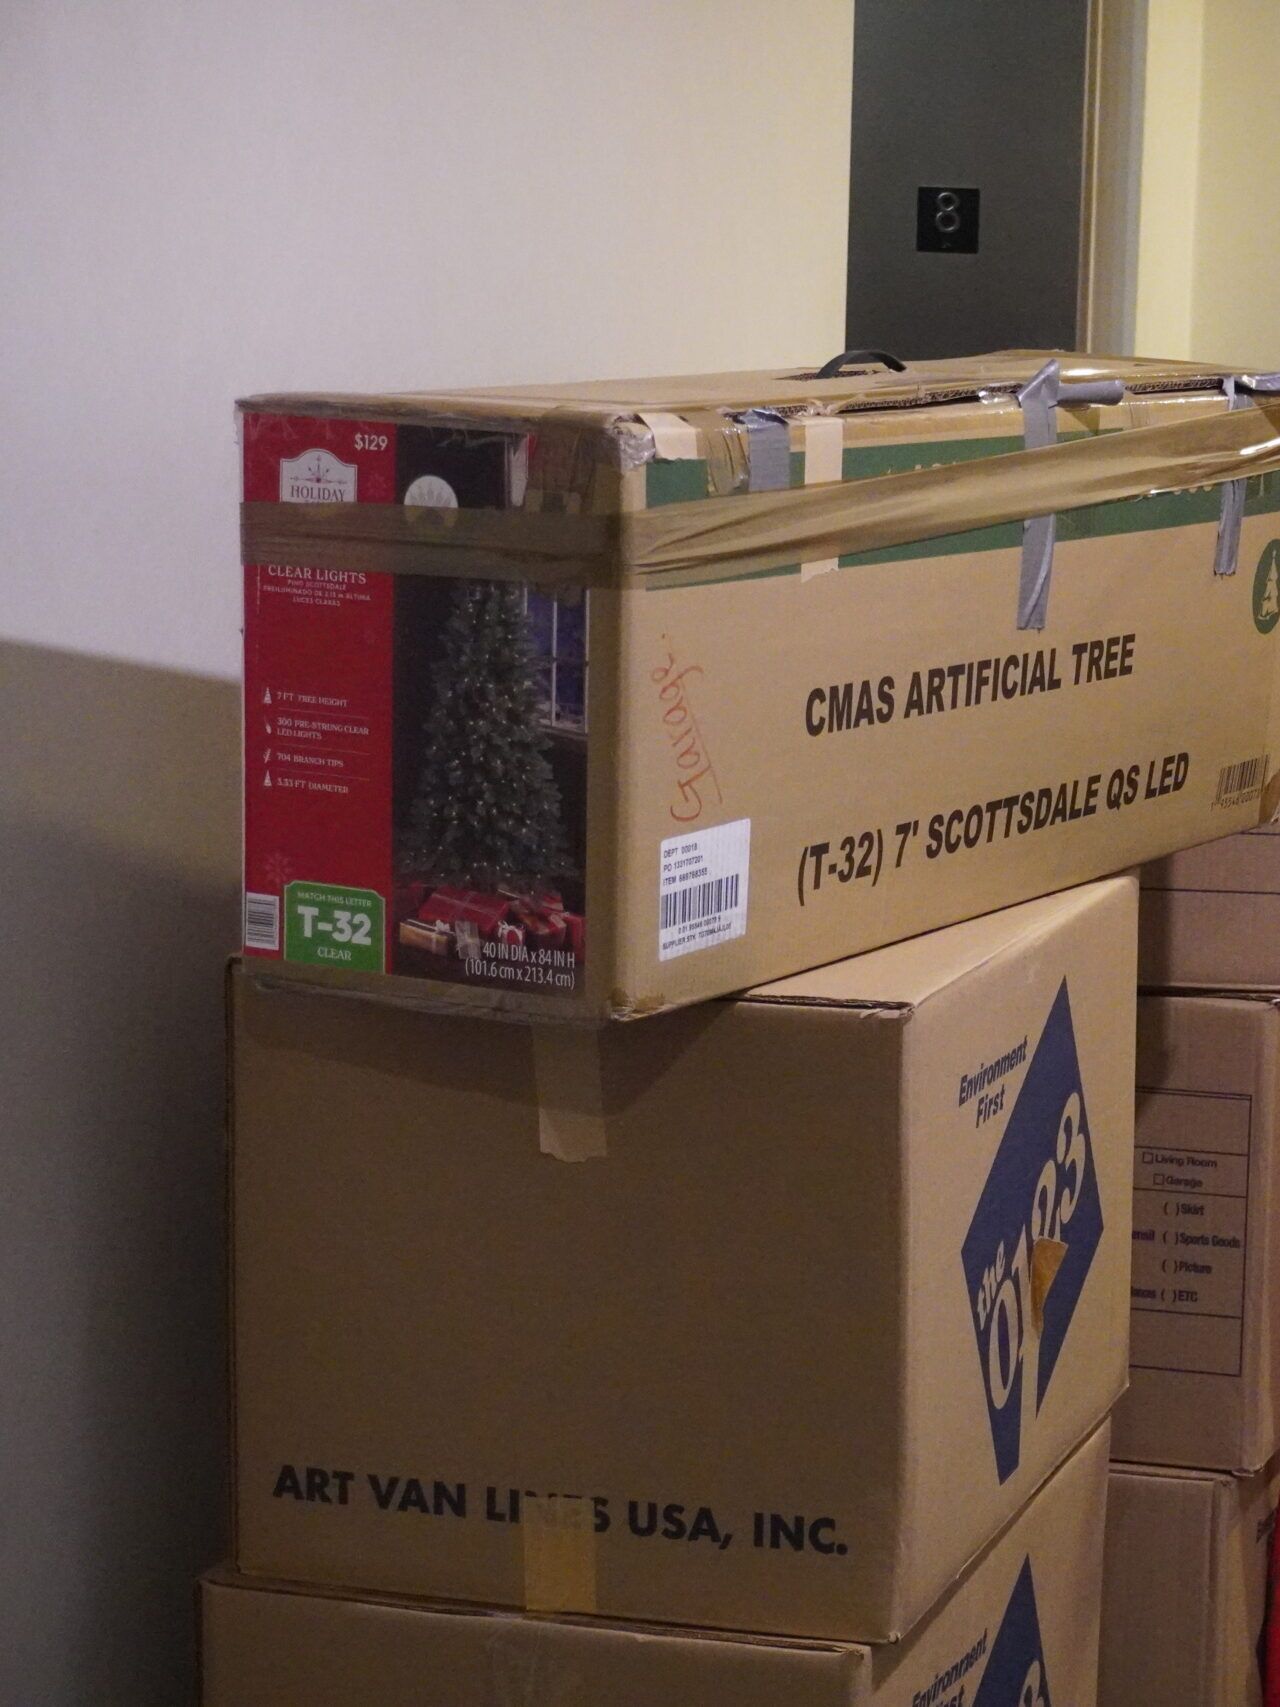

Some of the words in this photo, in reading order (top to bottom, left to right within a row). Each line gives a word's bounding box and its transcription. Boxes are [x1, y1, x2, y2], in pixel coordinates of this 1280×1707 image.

[936, 192, 961, 233] 8
[354, 433, 389, 452] $129
[290, 484, 346, 502] HOLIDAY
[268, 564, 312, 579] CLEAR
[316, 570, 367, 584] LIGHTS
[805, 676, 894, 736] CMAS
[903, 648, 1062, 719] ARTIFICIAL
[1072, 633, 1136, 687] TREE
[277, 728, 292, 737] LED
[293, 730, 322, 740] LIGHTS
[294, 719, 343, 732] PRE-STRUNG
[344, 725, 369, 735] CLEAR
[293, 755, 326, 766] BRANCH
[327, 759, 344, 768] TIPS
[308, 781, 349, 794] DIAMETER
[798, 828, 883, 906] (T-32)
[894, 822, 921, 869] 7'
[925, 772, 1102, 859] SCOTTSDALE
[1106, 768, 1138, 813] QS
[1145, 752, 1189, 800] LED
[663, 847, 678, 859] DEPT
[663, 863, 672, 873] PO
[663, 875, 677, 886] ITEM
[297, 891, 325, 902] MATCH
[326, 894, 344, 905] THIS
[345, 896, 372, 908] LETTER
[297, 905, 372, 946] T-32
[317, 946, 352, 961] CLEAR
[482, 941, 495, 959] 40
[497, 943, 509, 960] IN
[511, 944, 529, 963] DIA
[530, 951, 537, 964] x
[538, 947, 552, 965] 84
[553, 950, 566, 967] IN
[567, 952, 576, 969] H
[465, 957, 498, 978] (101.6
[499, 966, 515, 980] cm
[524, 965, 552, 985] 213.4
[555, 969, 575, 990] cm)
[959, 1035, 1028, 1107] Environment
[975, 1086, 1006, 1128] First
[1155, 1154, 1184, 1166] Living
[1187, 1154, 1218, 1168] Room
[1166, 1176, 1203, 1188] Garage
[1179, 1235, 1209, 1246] Sports
[1178, 1291, 1198, 1302] ETC
[273, 1464, 355, 1505] ART
[366, 1473, 467, 1519] VAN
[486, 1485, 611, 1533] LIS
[627, 1500, 734, 1551] USA,
[752, 1512, 849, 1557] INC.
